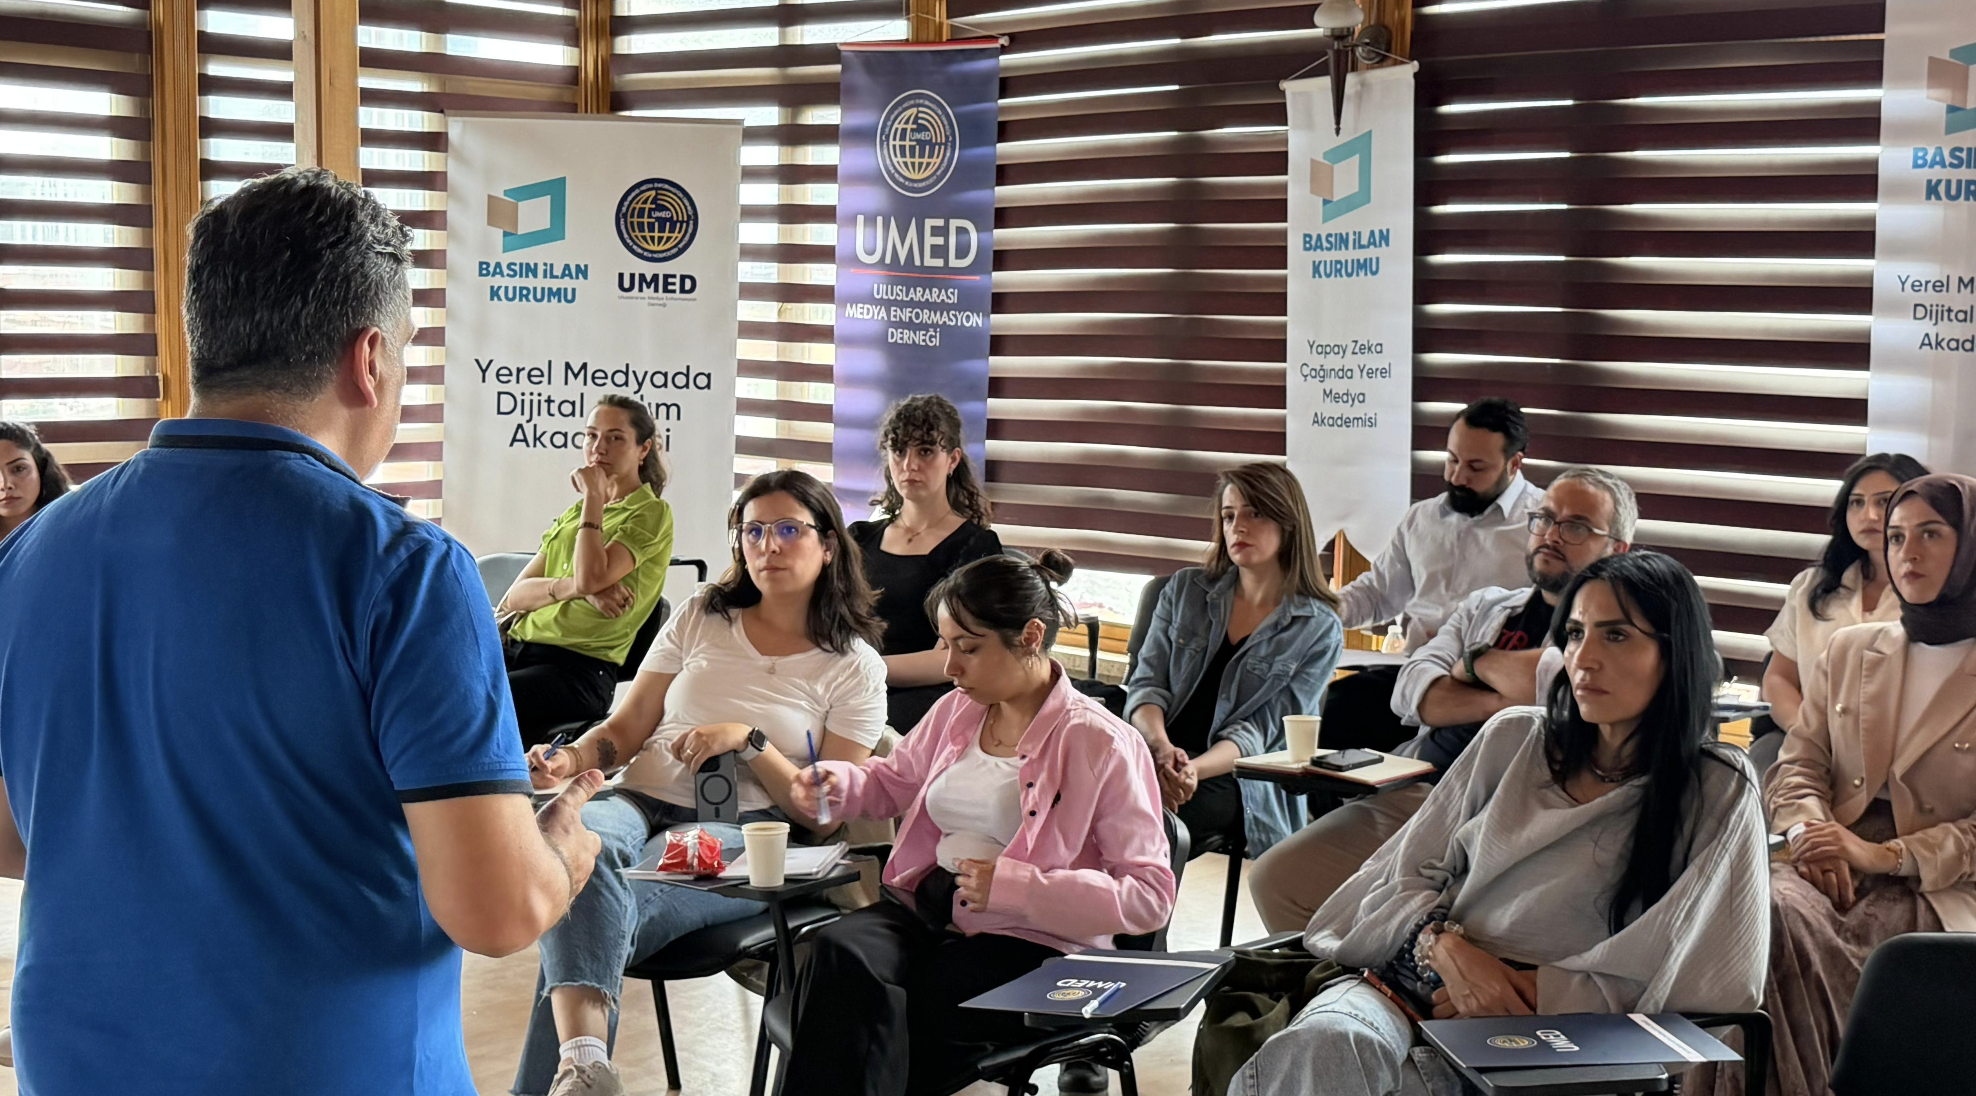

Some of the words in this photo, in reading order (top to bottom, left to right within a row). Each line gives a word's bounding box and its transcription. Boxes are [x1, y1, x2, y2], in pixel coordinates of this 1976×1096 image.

[1911, 146, 1976, 170] BASI
[855, 214, 978, 268] UMED
[1302, 231, 1349, 252] BASIN
[478, 260, 538, 279] BASIN
[1311, 256, 1380, 279] KURUMU
[617, 272, 697, 294] UMED
[873, 283, 958, 304] ULUSLARARASI
[1897, 274, 1950, 293] Yerel
[1957, 275, 1976, 294] M
[489, 284, 577, 304] KURUMU
[845, 303, 888, 321] MEDYA
[890, 306, 983, 328] ENFORMASYON
[1913, 303, 1974, 326] Dijital
[888, 327, 940, 347] DERNEĞİ
[1307, 339, 1348, 359] Yapay
[1351, 339, 1383, 355] Zeka
[474, 358, 552, 386] Yerel
[563, 361, 712, 394] Medyada
[1300, 362, 1354, 383] Çağında
[1357, 362, 1391, 379] Yerel
[496, 391, 584, 423] Dijital
[1323, 387, 1366, 407] Medya
[1311, 411, 1377, 428] Akademisi
[1535, 1029, 1580, 1052] UMED
